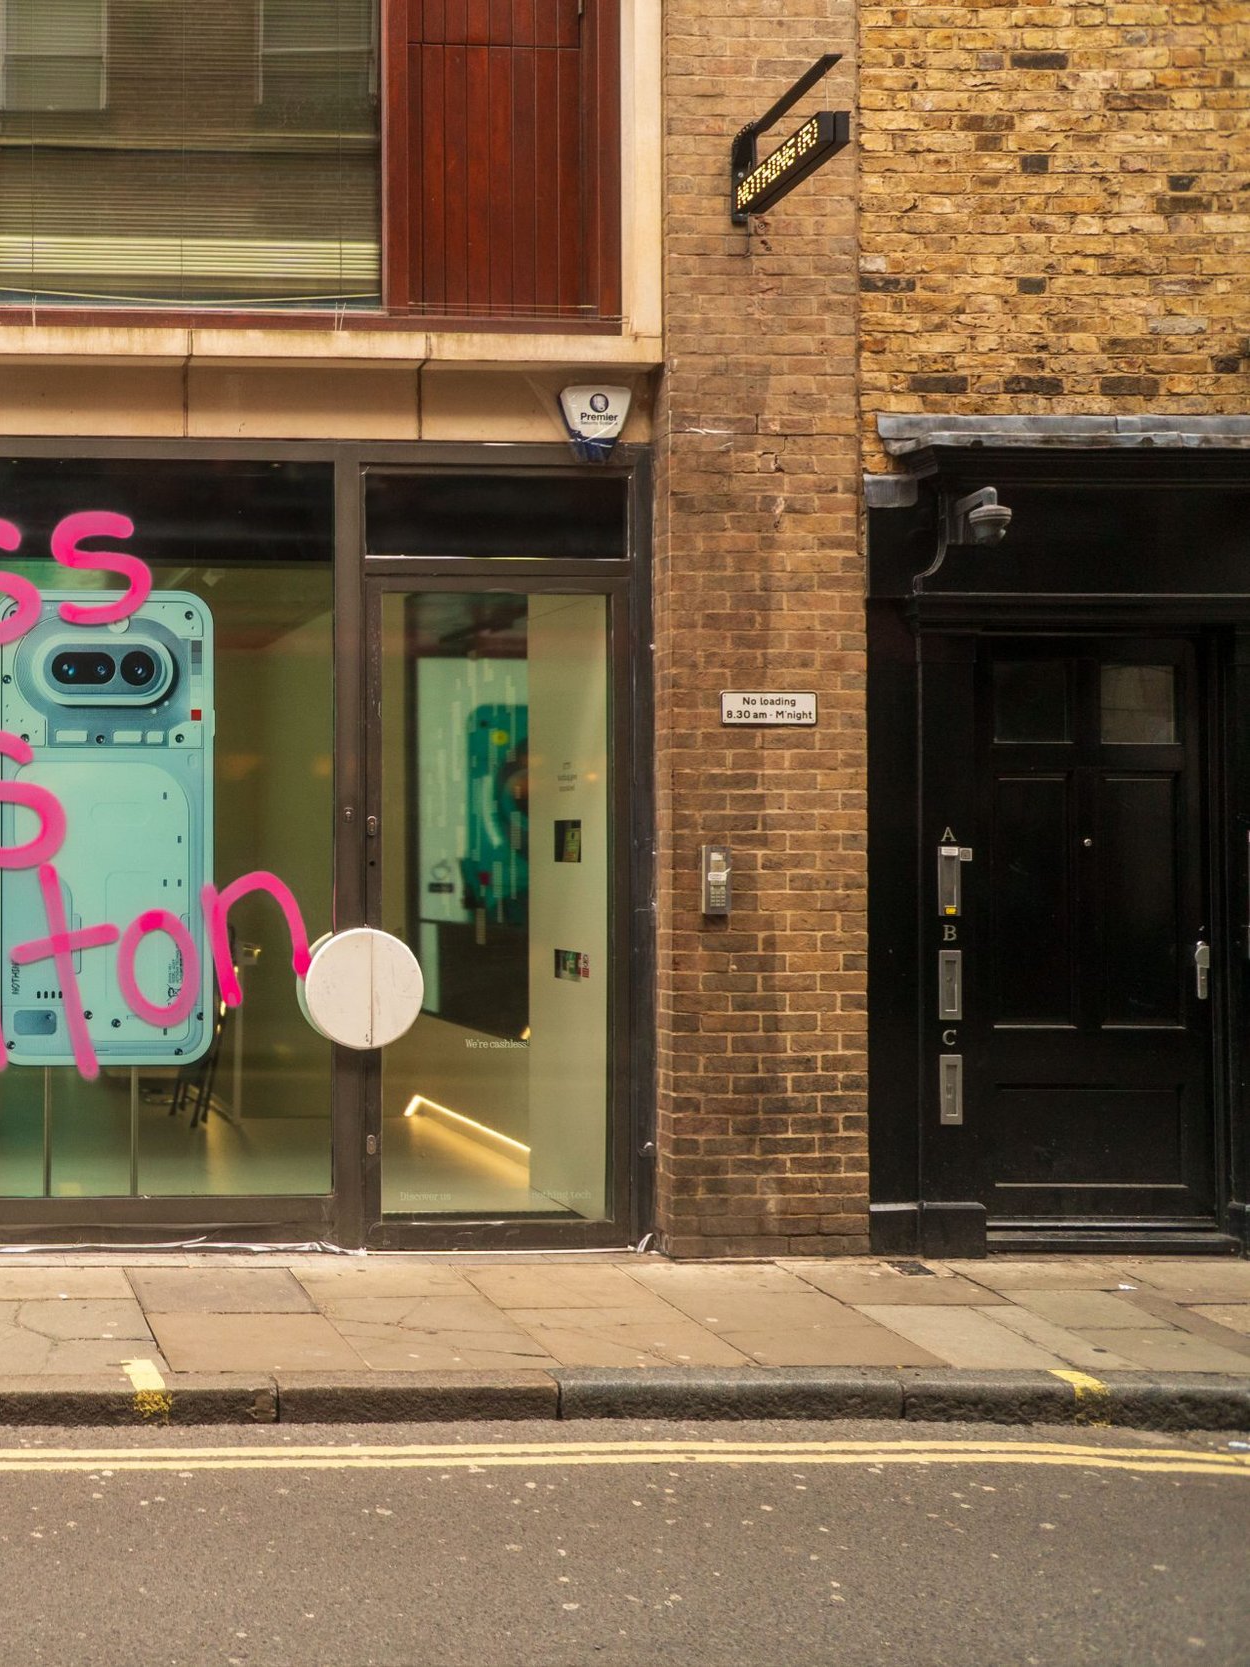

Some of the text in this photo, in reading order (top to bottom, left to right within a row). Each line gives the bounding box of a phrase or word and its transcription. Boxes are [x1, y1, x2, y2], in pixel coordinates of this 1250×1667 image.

[736, 137, 796, 210] NOTHING
[580, 412, 618, 422] Premier
[742, 697, 797, 708] No loading
[726, 710, 750, 719] 8.30
[753, 711, 767, 719] am
[775, 710, 813, 720] M'night
[941, 827, 957, 842] A
[943, 925, 957, 941] B
[11, 959, 20, 995] NOTHIN
[465, 1039, 488, 1049] We're
[942, 1030, 957, 1045] C
